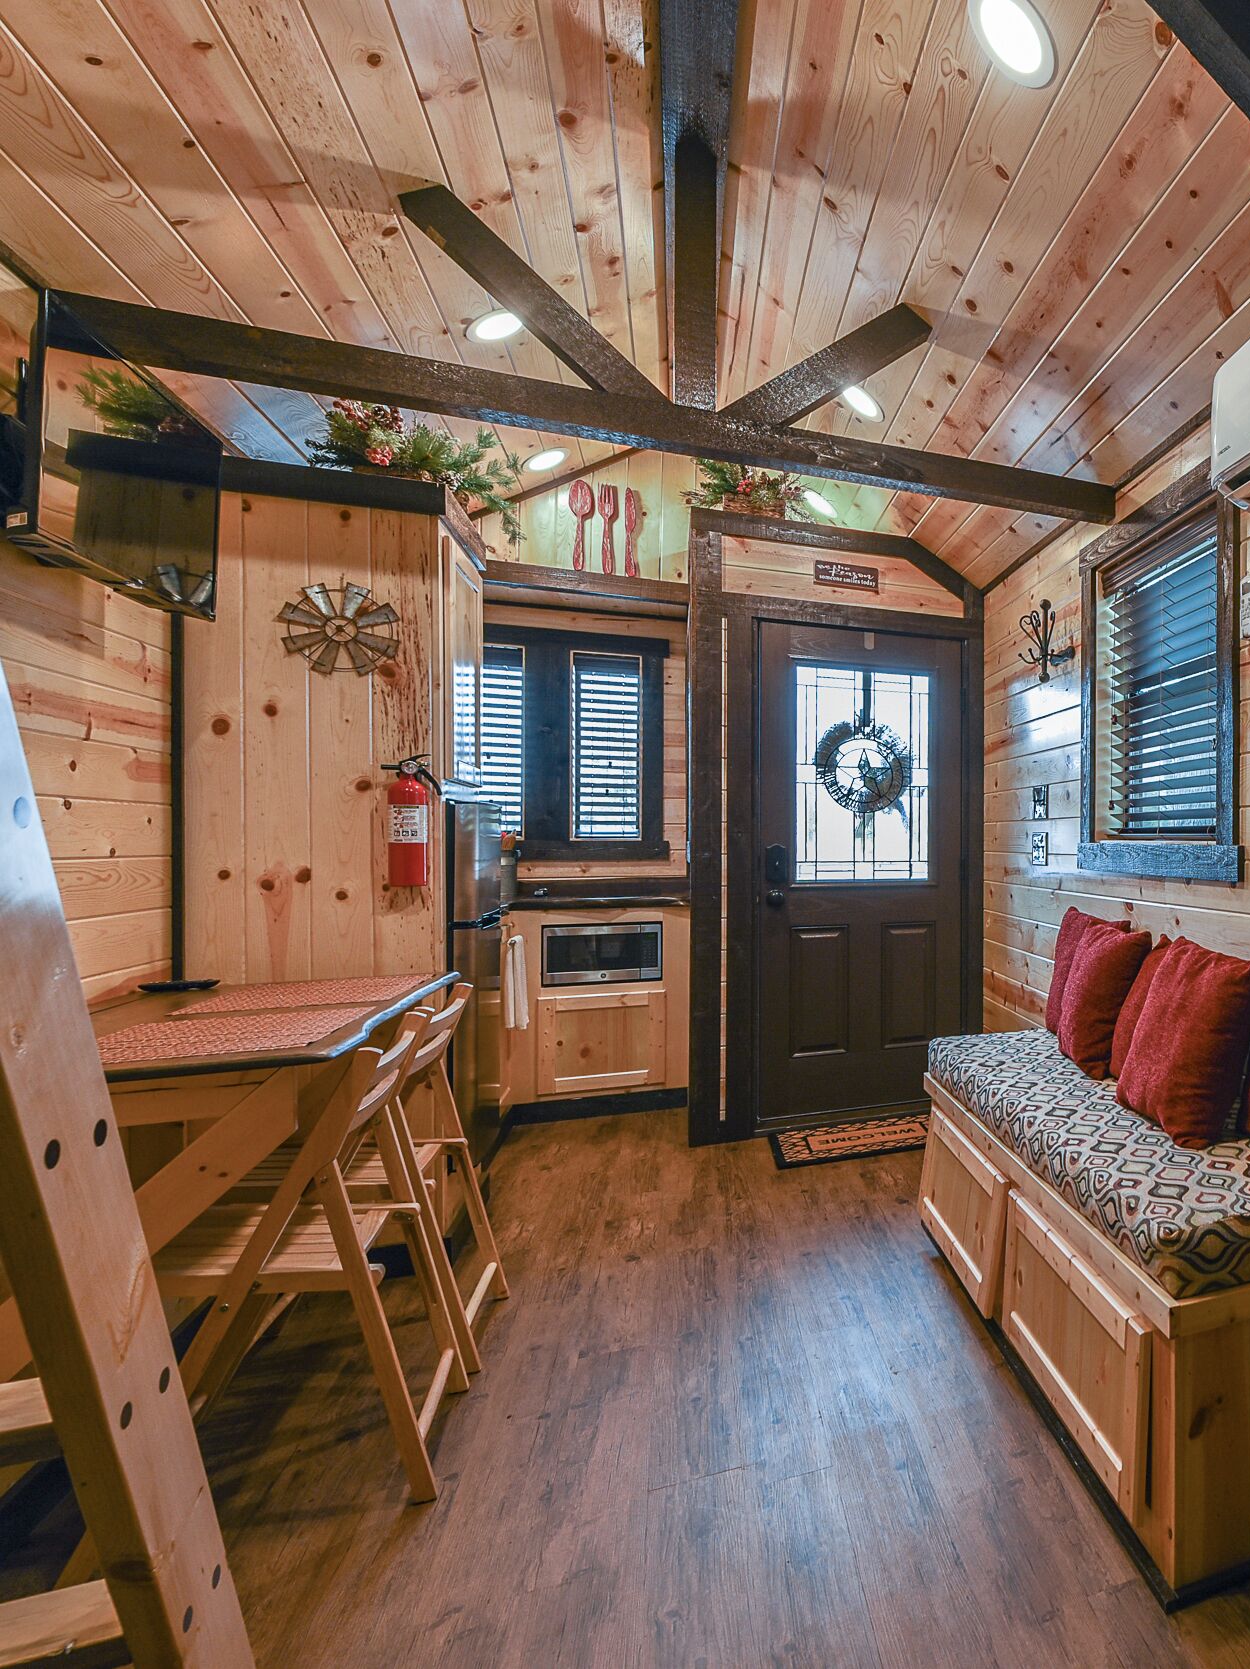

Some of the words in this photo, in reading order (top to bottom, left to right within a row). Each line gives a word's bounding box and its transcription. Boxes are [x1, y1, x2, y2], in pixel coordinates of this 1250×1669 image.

[819, 574, 843, 582] someone
[861, 579, 876, 587] today
[817, 1127, 917, 1146] WELCOME
